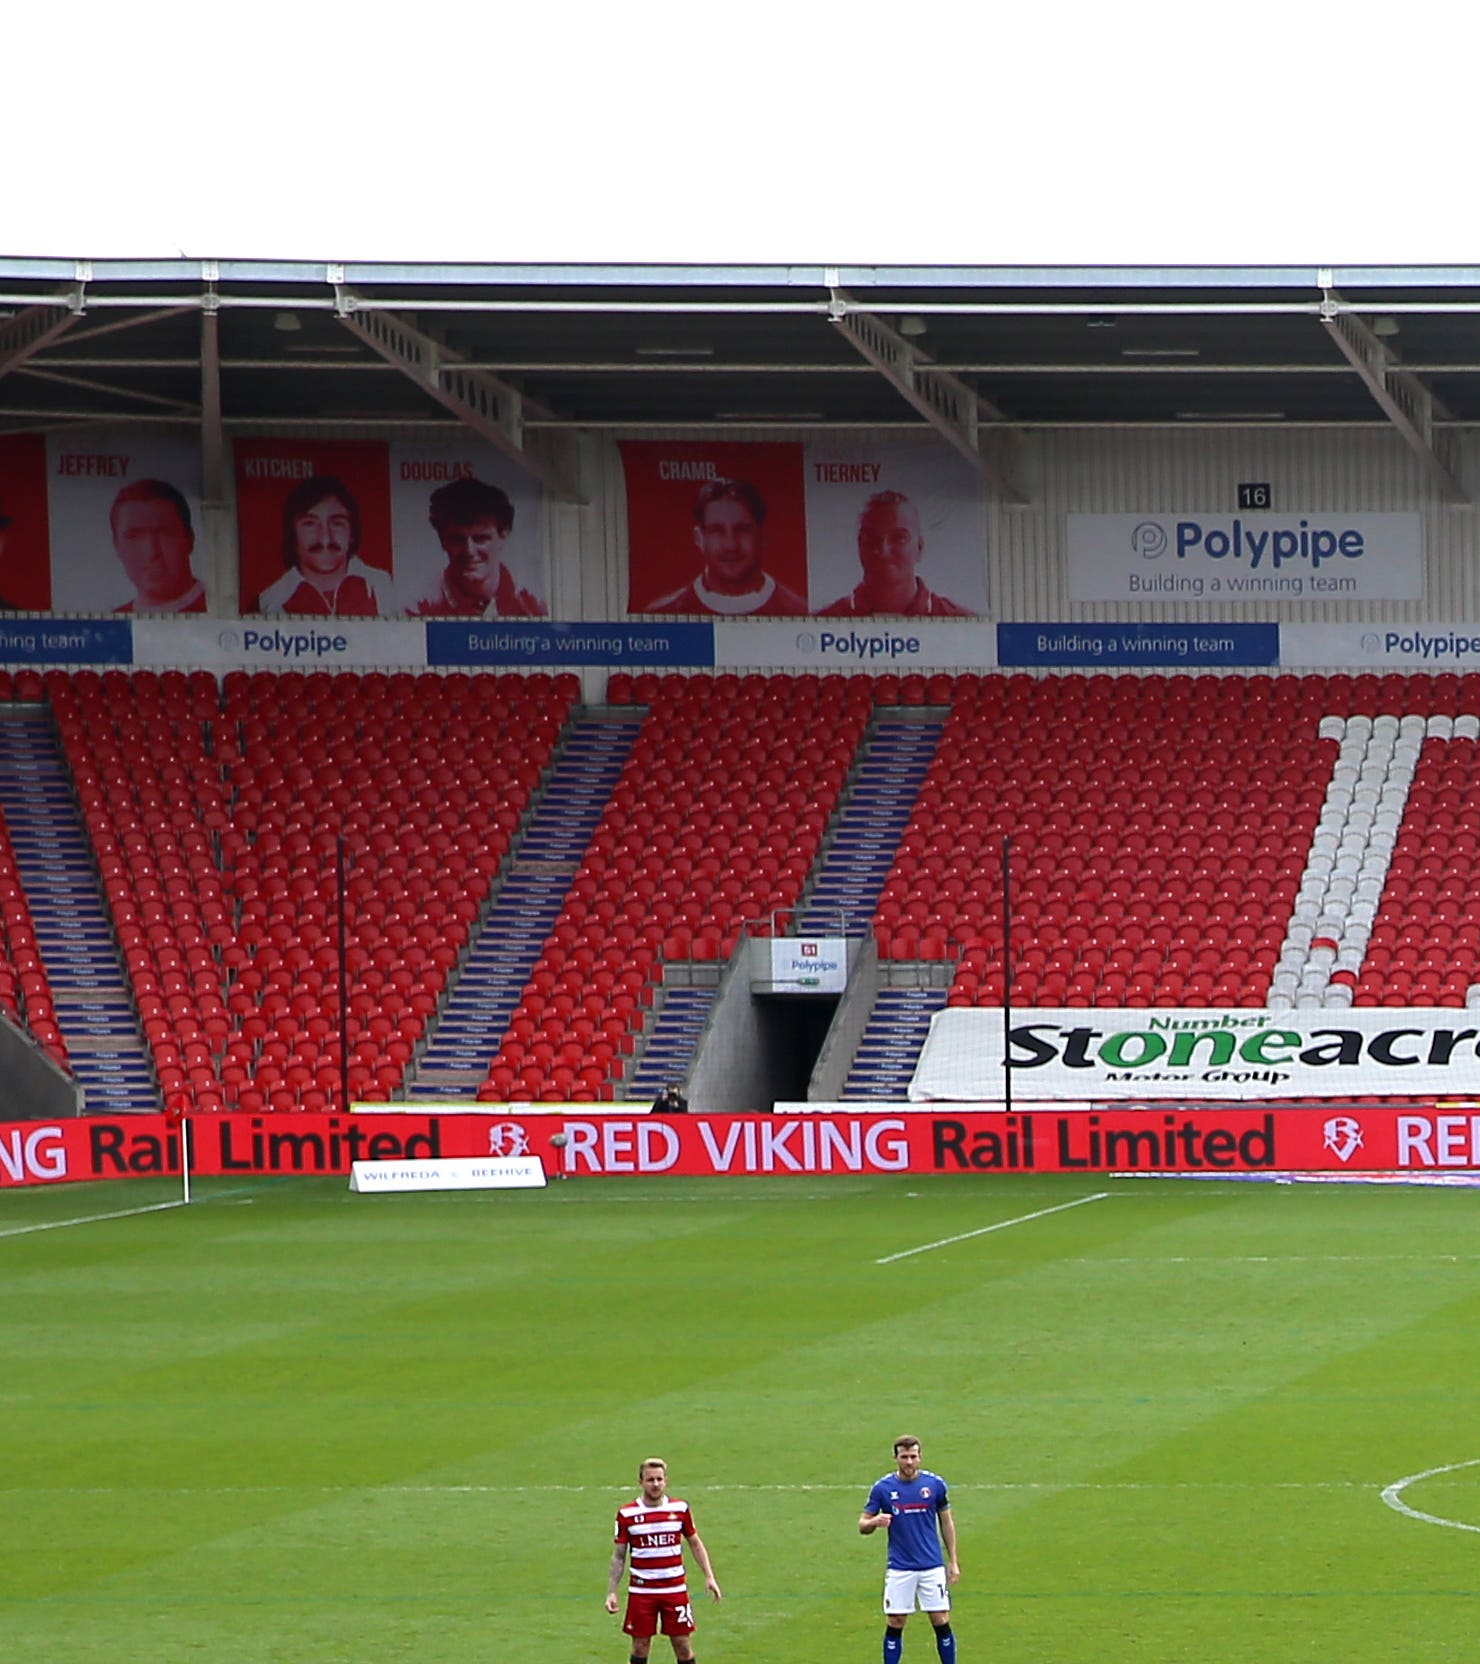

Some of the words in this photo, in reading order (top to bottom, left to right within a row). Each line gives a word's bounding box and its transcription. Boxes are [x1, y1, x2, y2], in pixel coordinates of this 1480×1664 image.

[57, 454, 130, 477] JEFFREY
[245, 457, 313, 480] KITCHEN
[401, 460, 474, 481] DOUGLAS
[659, 460, 717, 481] CRAMB
[814, 463, 881, 484] TIERNEY
[1242, 488, 1267, 505] 16
[1176, 520, 1365, 568] Polypipe
[1128, 573, 1204, 596] Building
[1210, 577, 1222, 592] a
[1227, 574, 1303, 596] winning
[1310, 575, 1357, 592] team
[42, 630, 86, 649] team
[243, 629, 348, 656] Polypipe
[468, 633, 537, 655] Building
[555, 634, 623, 656] winning
[628, 634, 670, 651] team
[820, 631, 921, 659] Polypipe
[1037, 634, 1102, 657] Building
[1121, 635, 1188, 657] winning
[1193, 635, 1235, 652] team
[1148, 1013, 1272, 1031] Number
[1200, 1069, 1291, 1085] Group
[219, 1117, 442, 1169] Limited
[562, 1121, 680, 1172] RED
[698, 1120, 909, 1172] VIKING
[933, 1116, 1033, 1170] Rail
[1058, 1113, 1276, 1169] Limited
